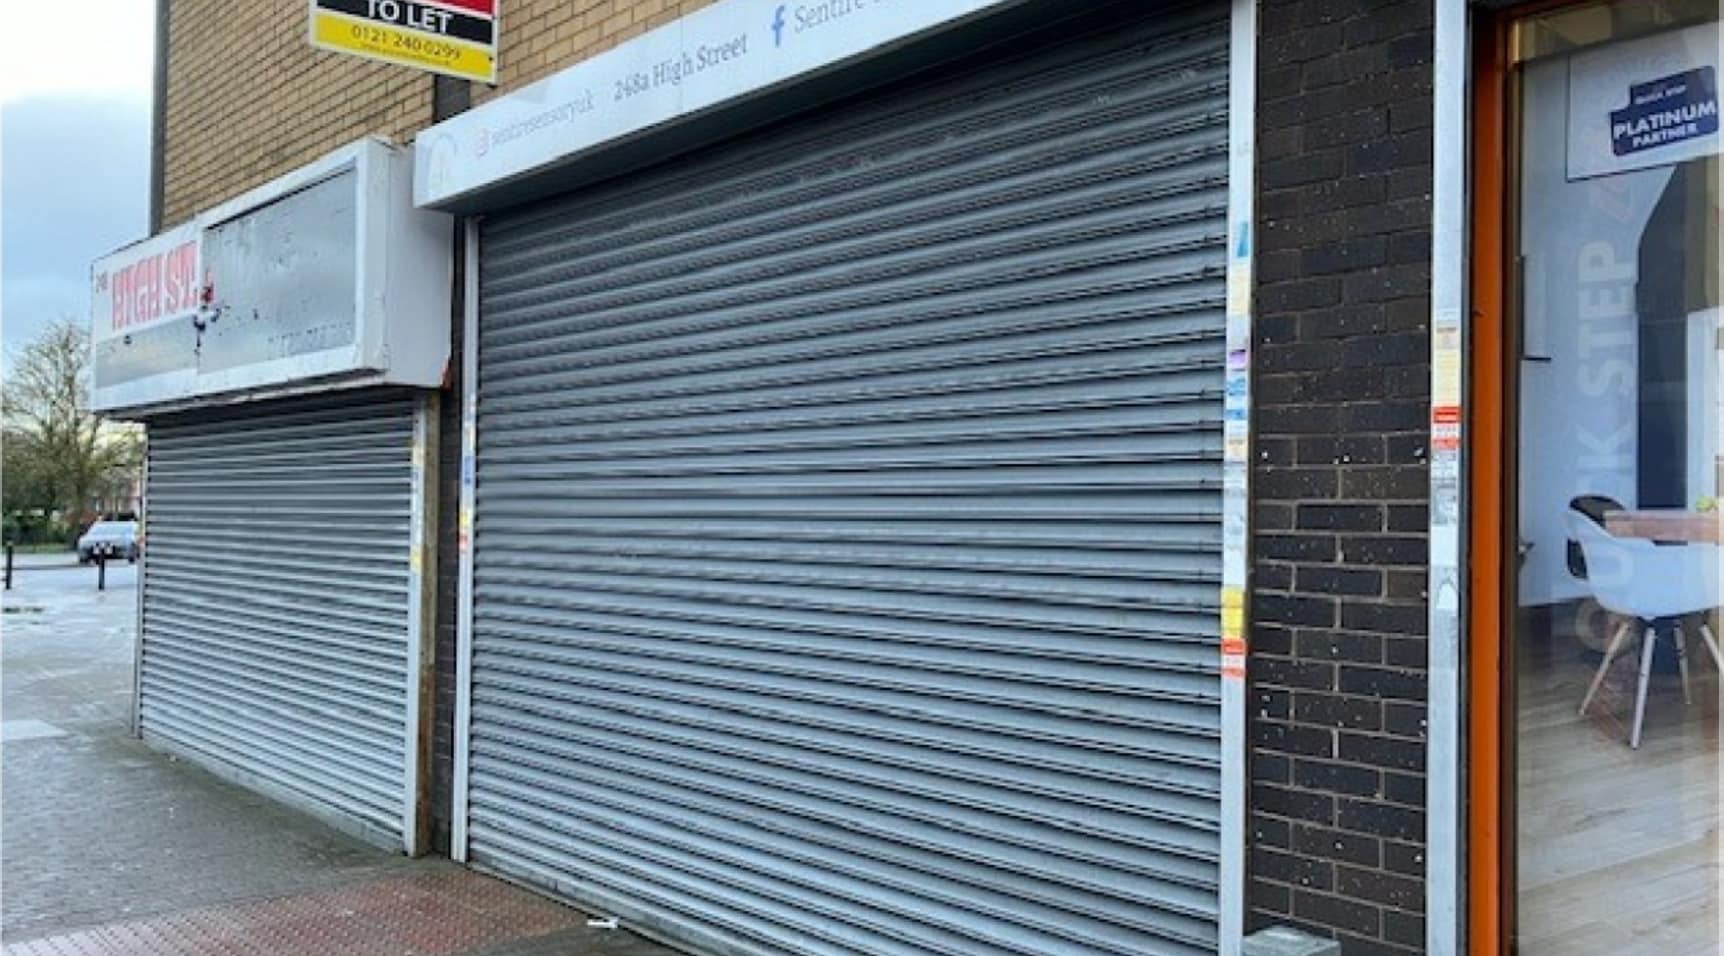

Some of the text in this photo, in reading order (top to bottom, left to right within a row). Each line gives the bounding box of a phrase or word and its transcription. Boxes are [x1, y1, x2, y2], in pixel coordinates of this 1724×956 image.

[368, 0, 453, 33] TO LET
[351, 24, 388, 44] 0121
[393, 32, 422, 51] 240
[424, 40, 460, 60] 0299
[652, 51, 694, 87] High
[696, 33, 747, 72] Street
[1613, 100, 1716, 140] PLATINUM
[1632, 122, 1698, 148] PARTNER
[112, 253, 162, 332] HIGH
[1574, 240, 1637, 655] QUK STEP
